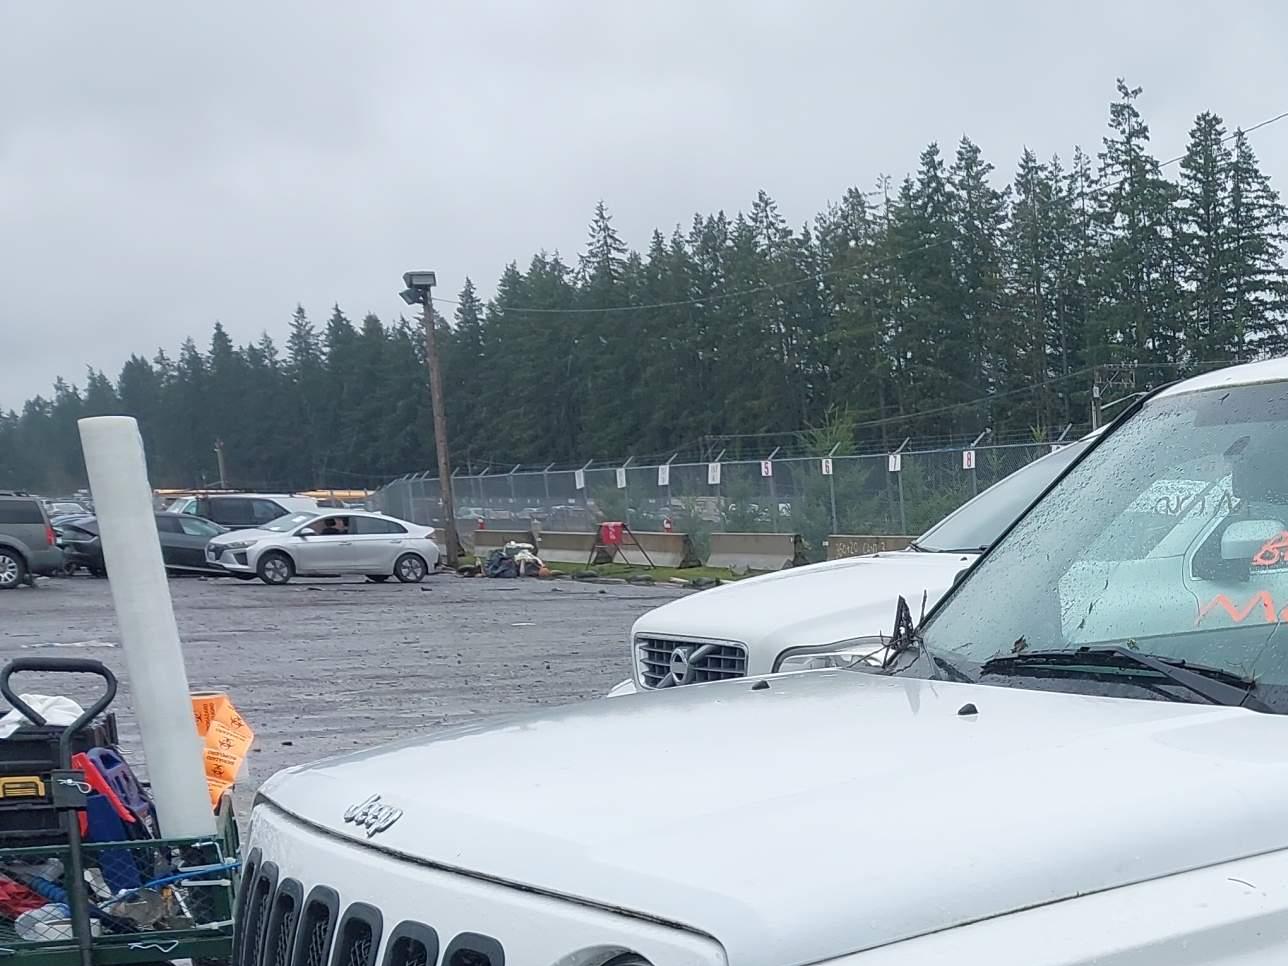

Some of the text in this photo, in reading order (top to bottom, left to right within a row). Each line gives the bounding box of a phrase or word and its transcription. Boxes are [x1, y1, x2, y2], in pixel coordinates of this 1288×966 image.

[824, 459, 830, 473] 6
[891, 455, 898, 469] 7
[966, 451, 972, 467] 8
[763, 462, 769, 475] 5
